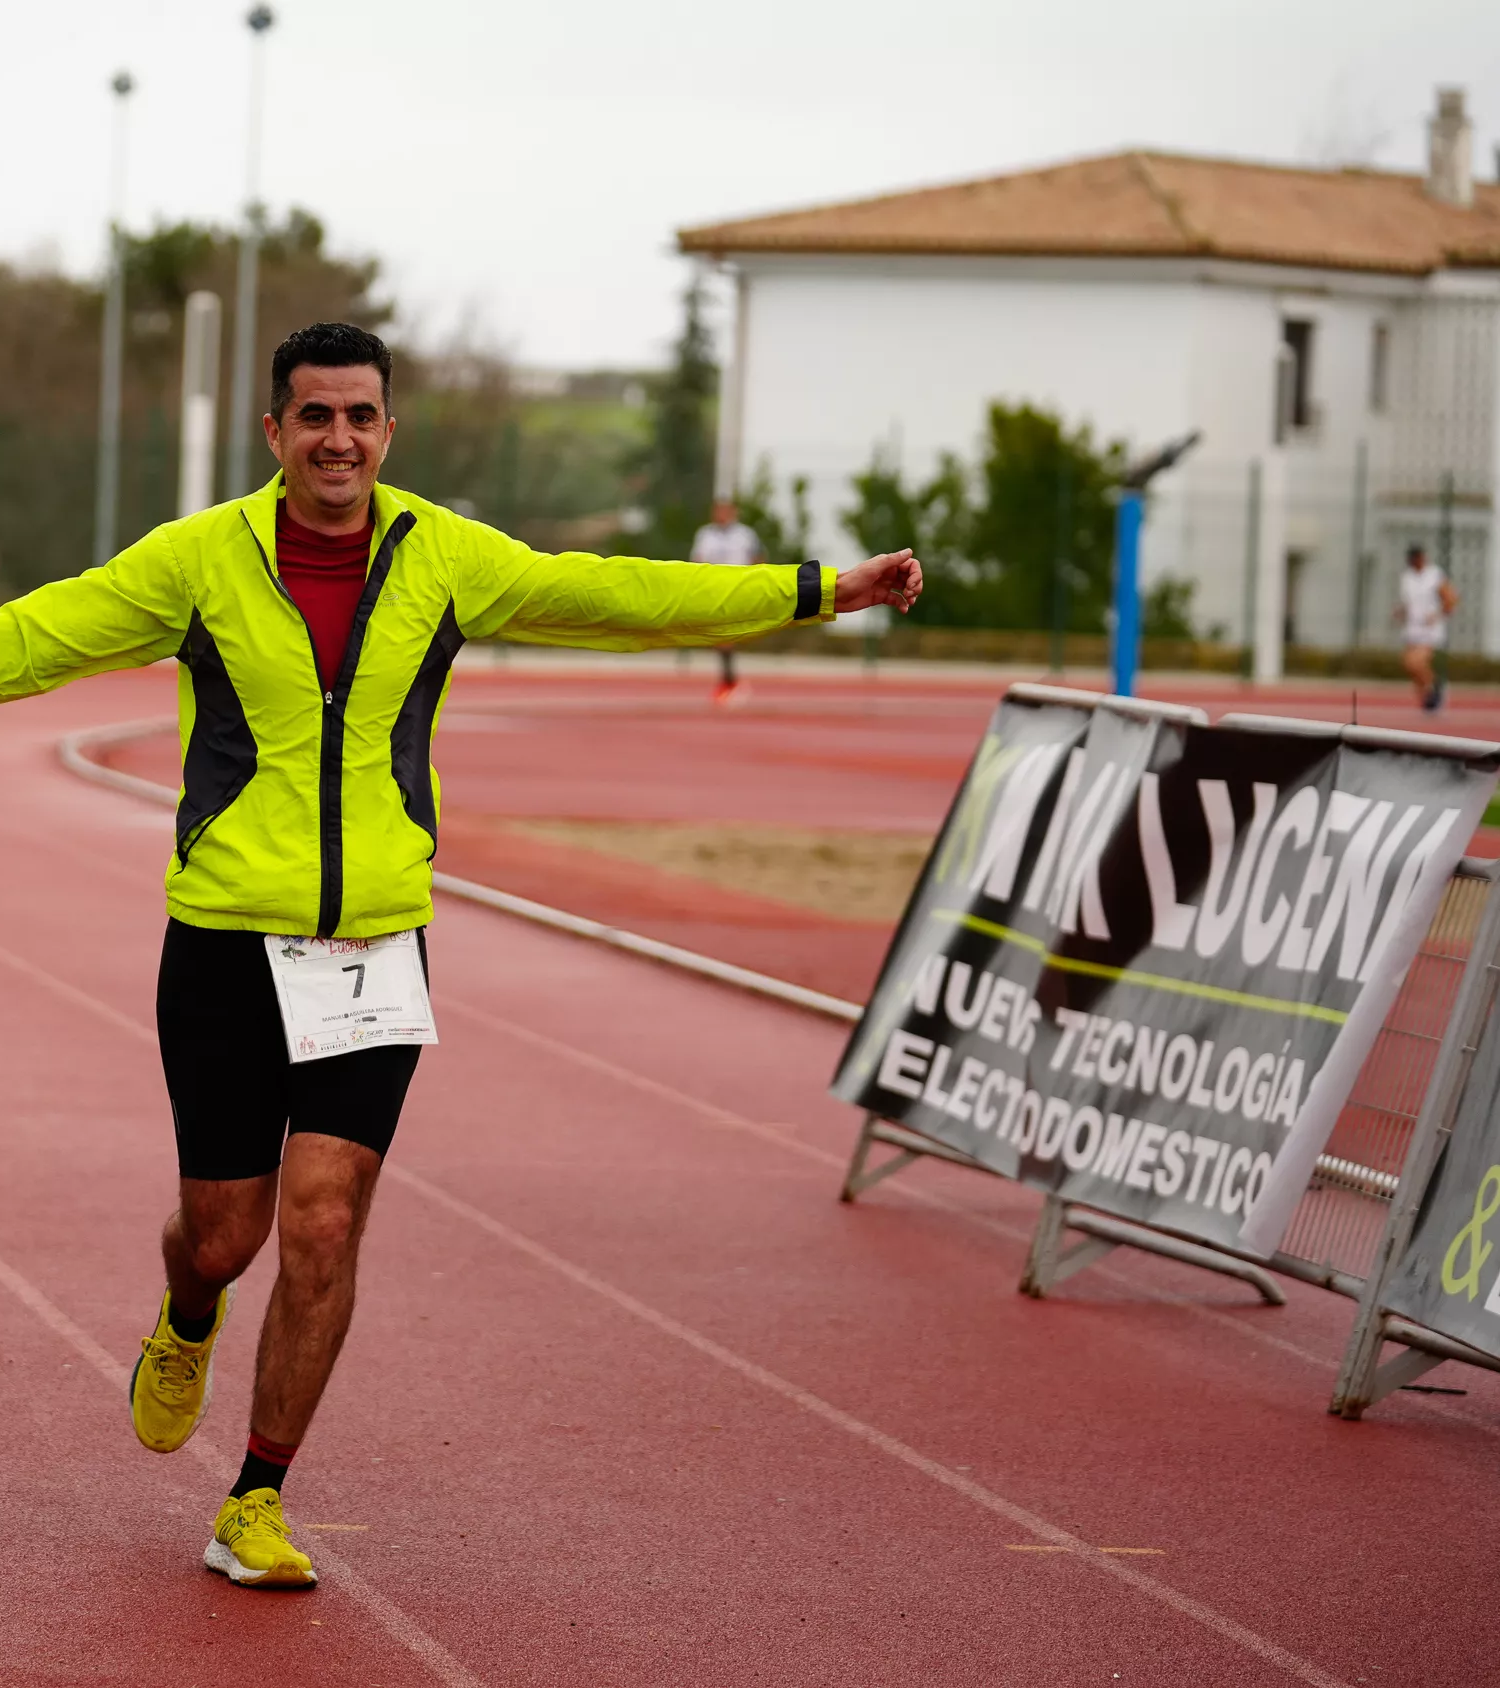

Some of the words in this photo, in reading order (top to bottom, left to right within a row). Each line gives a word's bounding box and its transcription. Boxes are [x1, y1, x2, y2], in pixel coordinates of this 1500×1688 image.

[1138, 772, 1462, 982] LUCENA
[329, 939, 376, 955] LUCENA
[341, 963, 365, 998] 7
[877, 1028, 1273, 1219] ELECTODOMESTICO
[1049, 1006, 1306, 1127] TECNOLOGÍA
